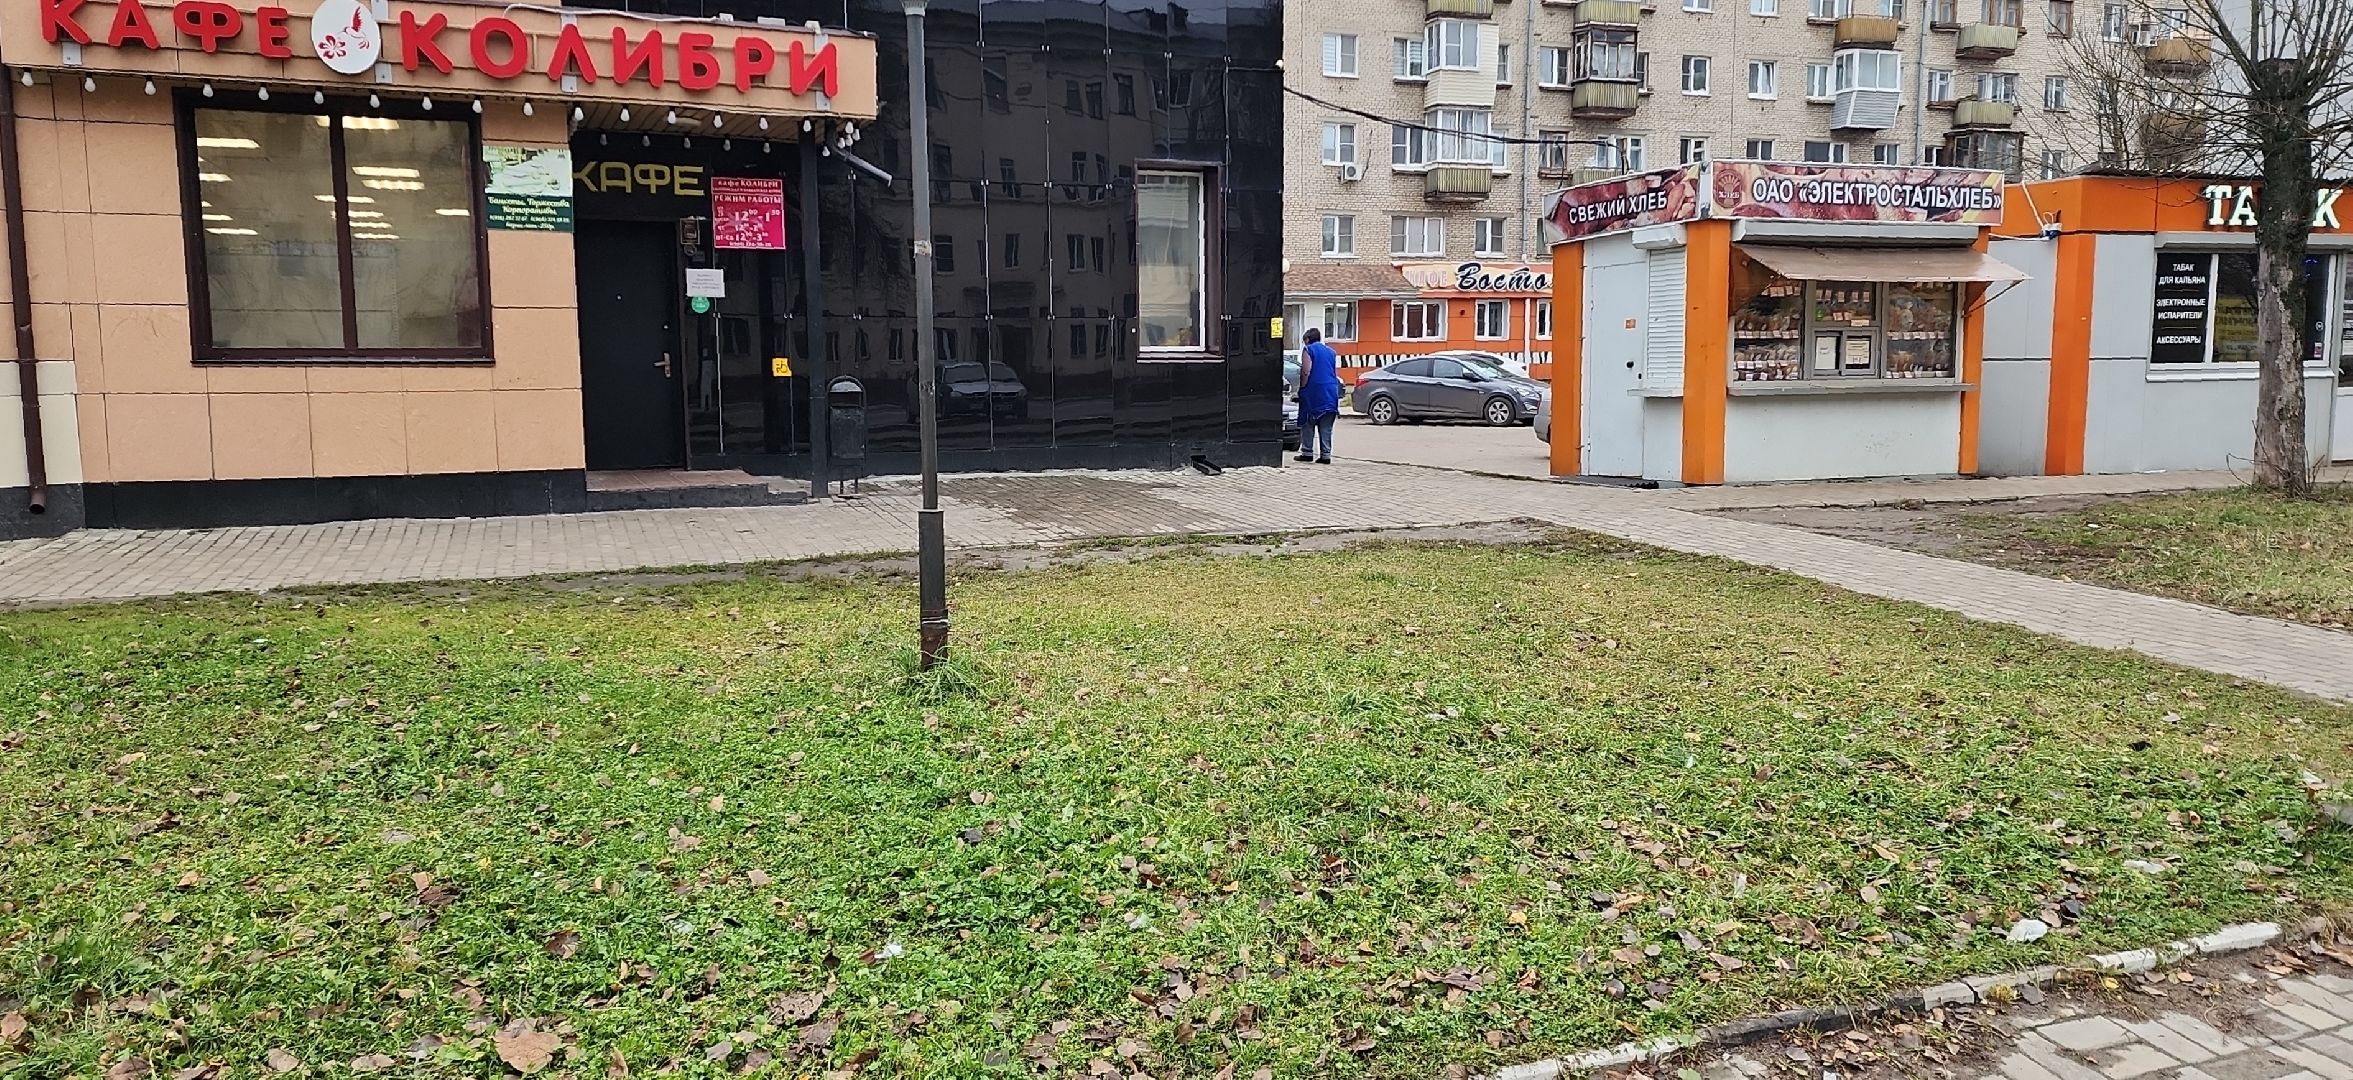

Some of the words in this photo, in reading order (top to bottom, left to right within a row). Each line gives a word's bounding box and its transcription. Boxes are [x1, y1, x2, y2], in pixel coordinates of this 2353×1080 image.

[41, 0, 292, 59] КАФЕ
[400, 10, 838, 97] КОЛИБРИ
[573, 161, 705, 195] КАФЕ
[747, 196, 781, 204] РАБОТЫ
[1752, 178, 1794, 203] ОАО
[1799, 181, 2001, 210] «ЭЛЕКТРОСТАЛЬХЛЕБ»
[1569, 196, 1627, 224] СВЕЖИЙ
[1628, 190, 1668, 215] ХЛЕБ
[2205, 185, 2343, 229] ТАК
[1457, 262, 1552, 291] Восто
[2172, 263, 2195, 272] ТАБАК
[2158, 276, 2174, 286] ДЛЯ
[2174, 276, 2206, 285] КАЛЬЯНА
[2156, 298, 2206, 307] ЭЛЕКТРОННЫЕ
[2157, 311, 2203, 320] ИСПАРИТЕЛИ
[2156, 336, 2202, 344] АКСЕССУАРЫ
